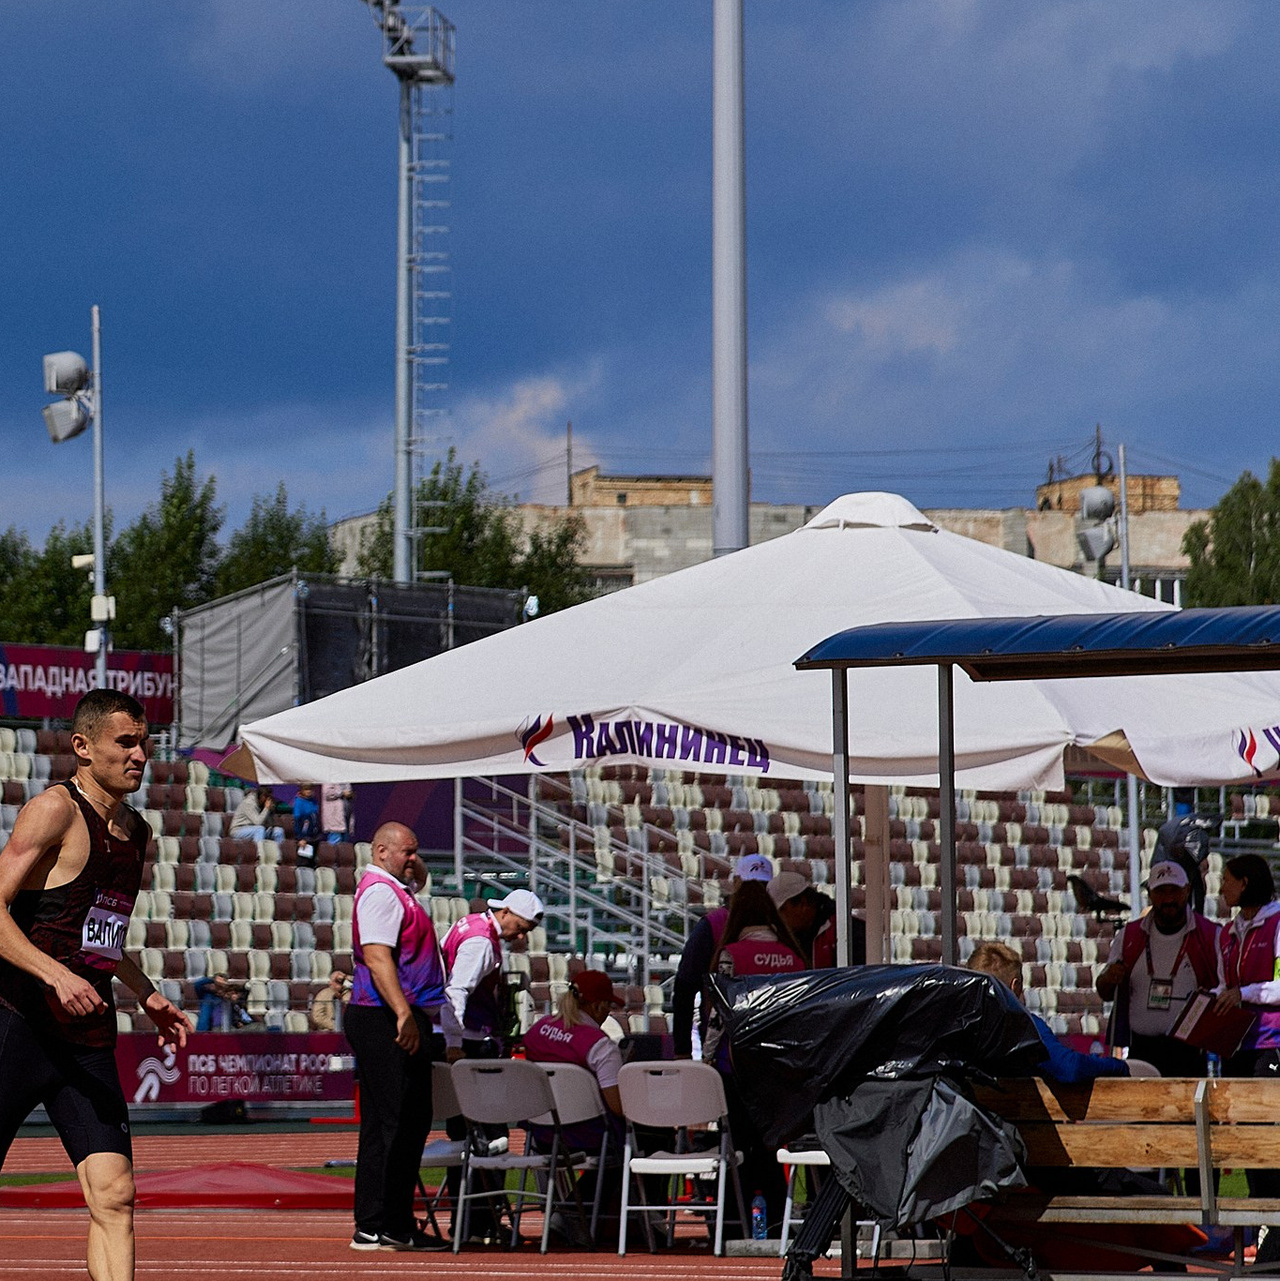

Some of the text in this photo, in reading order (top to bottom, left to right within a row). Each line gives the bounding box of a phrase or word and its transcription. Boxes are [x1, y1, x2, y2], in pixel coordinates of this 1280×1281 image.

[566, 713, 771, 773] КАЛИНИНЕЦ
[754, 953, 793, 968] СУДЬЯ
[540, 1024, 573, 1043] СУДЬЯ
[188, 1053, 216, 1072] ПСБ
[218, 1053, 297, 1073] ЧЕМПИОНАТ
[188, 1073, 323, 1096] ПО ЛЕГКОЙ АТЛЕТИКЕ
